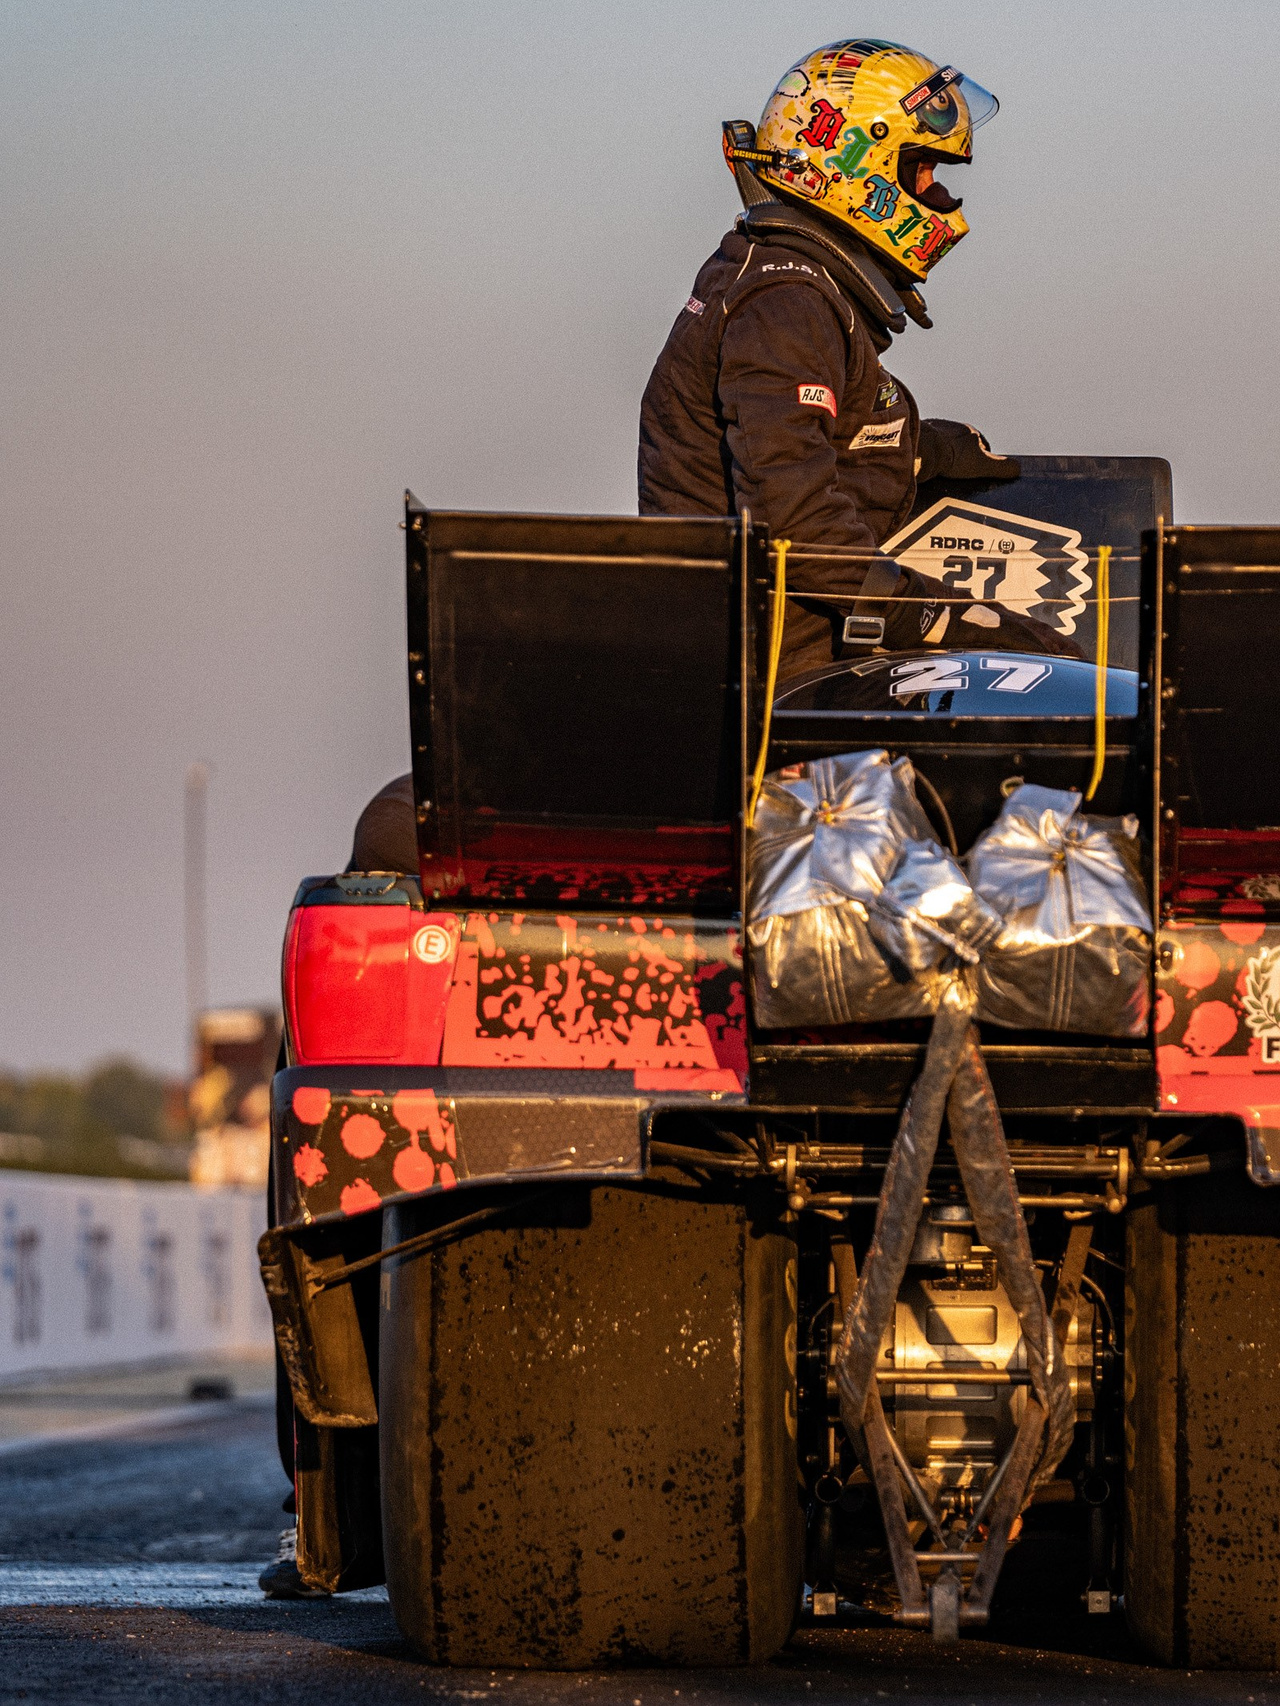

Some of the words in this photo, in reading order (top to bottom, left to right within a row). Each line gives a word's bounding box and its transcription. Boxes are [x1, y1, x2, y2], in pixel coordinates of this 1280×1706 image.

[907, 86, 929, 108] SIMPSON
[761, 261, 818, 277] R.J.S.
[801, 388, 825, 402] RJS
[929, 536, 984, 551] RDRC
[942, 555, 1007, 599] 27
[890, 656, 1053, 696] 27
